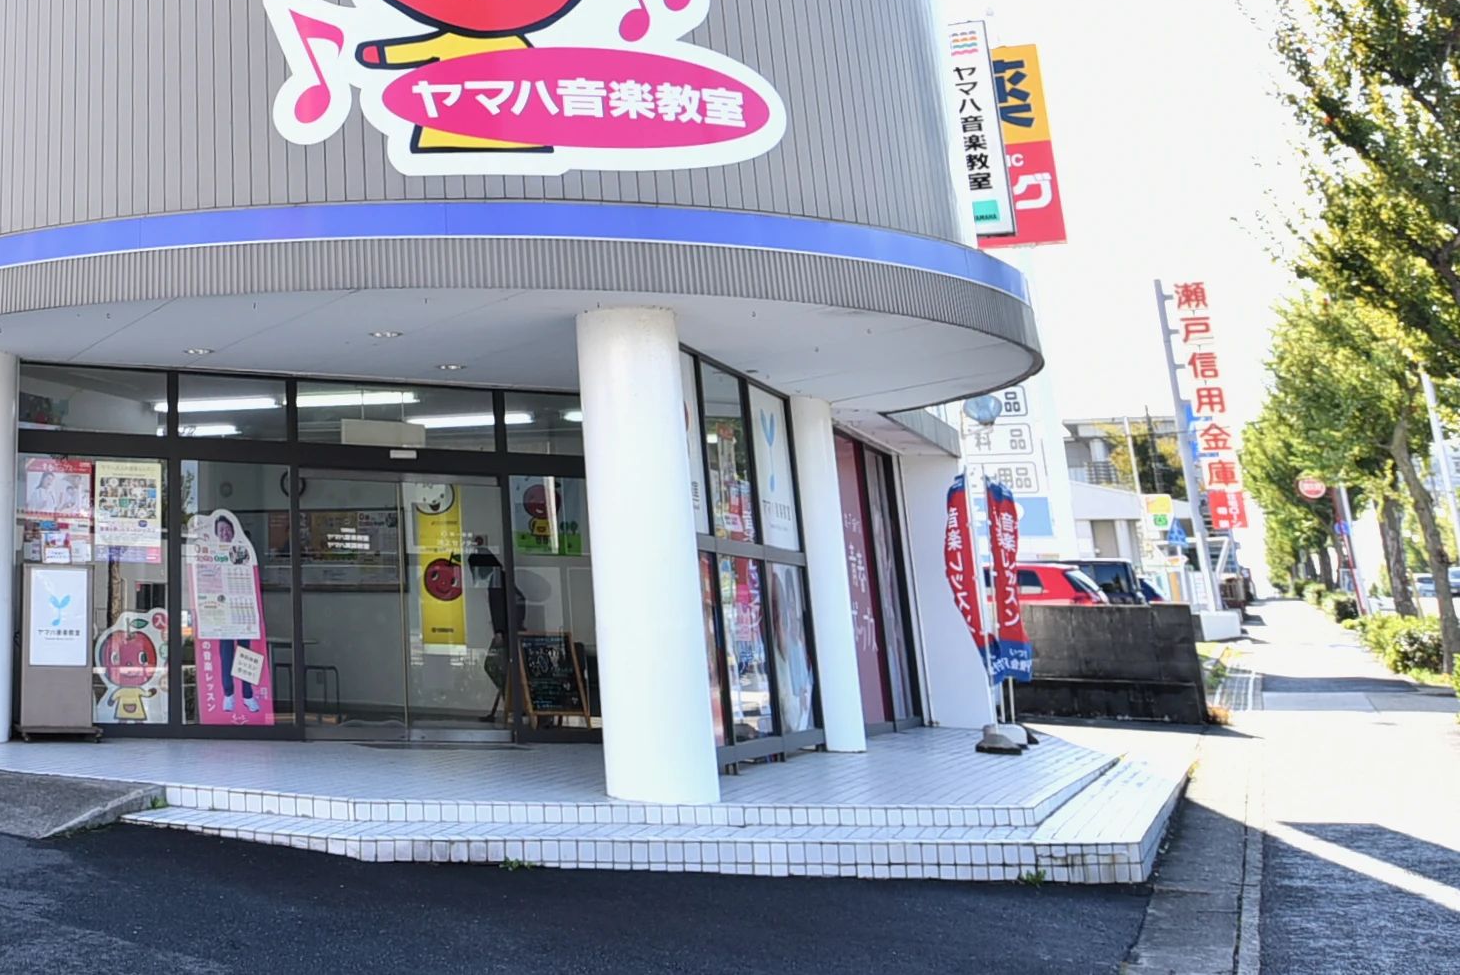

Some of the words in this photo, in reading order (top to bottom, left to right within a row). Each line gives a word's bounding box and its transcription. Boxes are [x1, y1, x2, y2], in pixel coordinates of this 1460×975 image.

[412, 77, 747, 128] ヤマハ音楽教室
[953, 66, 993, 191] ヤマハ音楽教室
[1174, 281, 1239, 486] 瀬戸信用金庫
